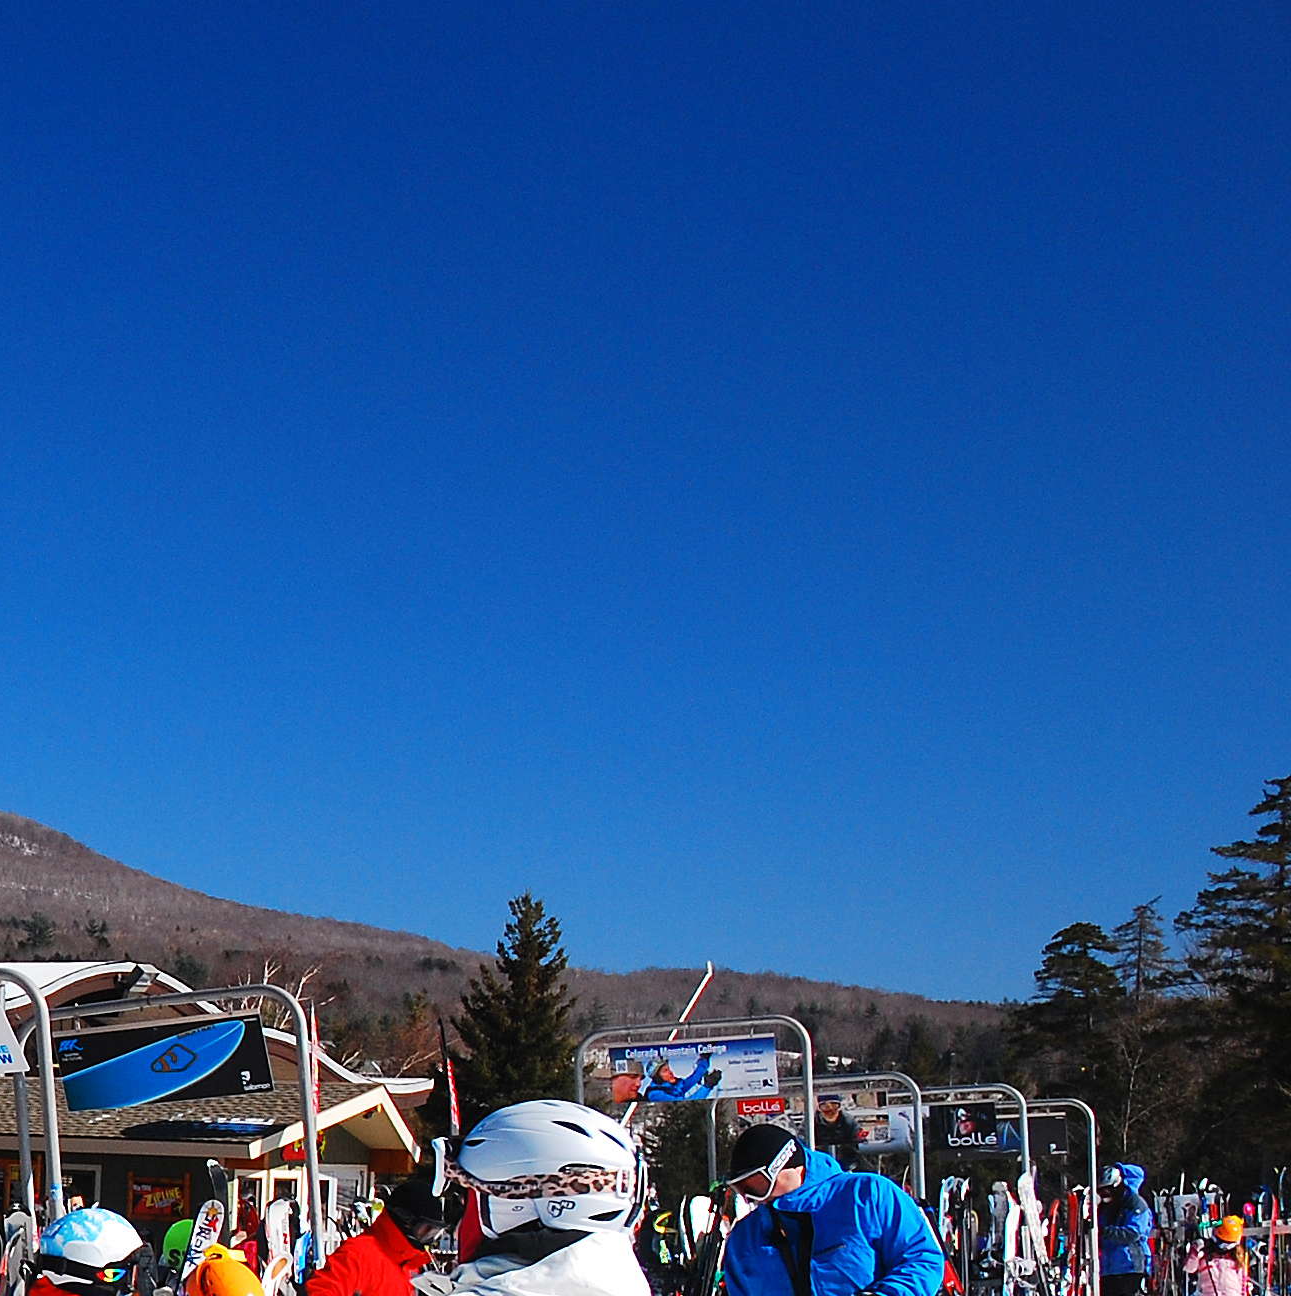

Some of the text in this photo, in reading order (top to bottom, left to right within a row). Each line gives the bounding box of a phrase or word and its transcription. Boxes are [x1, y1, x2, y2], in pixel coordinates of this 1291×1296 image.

[624, 1044, 727, 1059] Colorado Mountain College
[947, 1127, 998, 1147] bollé
[144, 1187, 181, 1208] ZIPLINE
